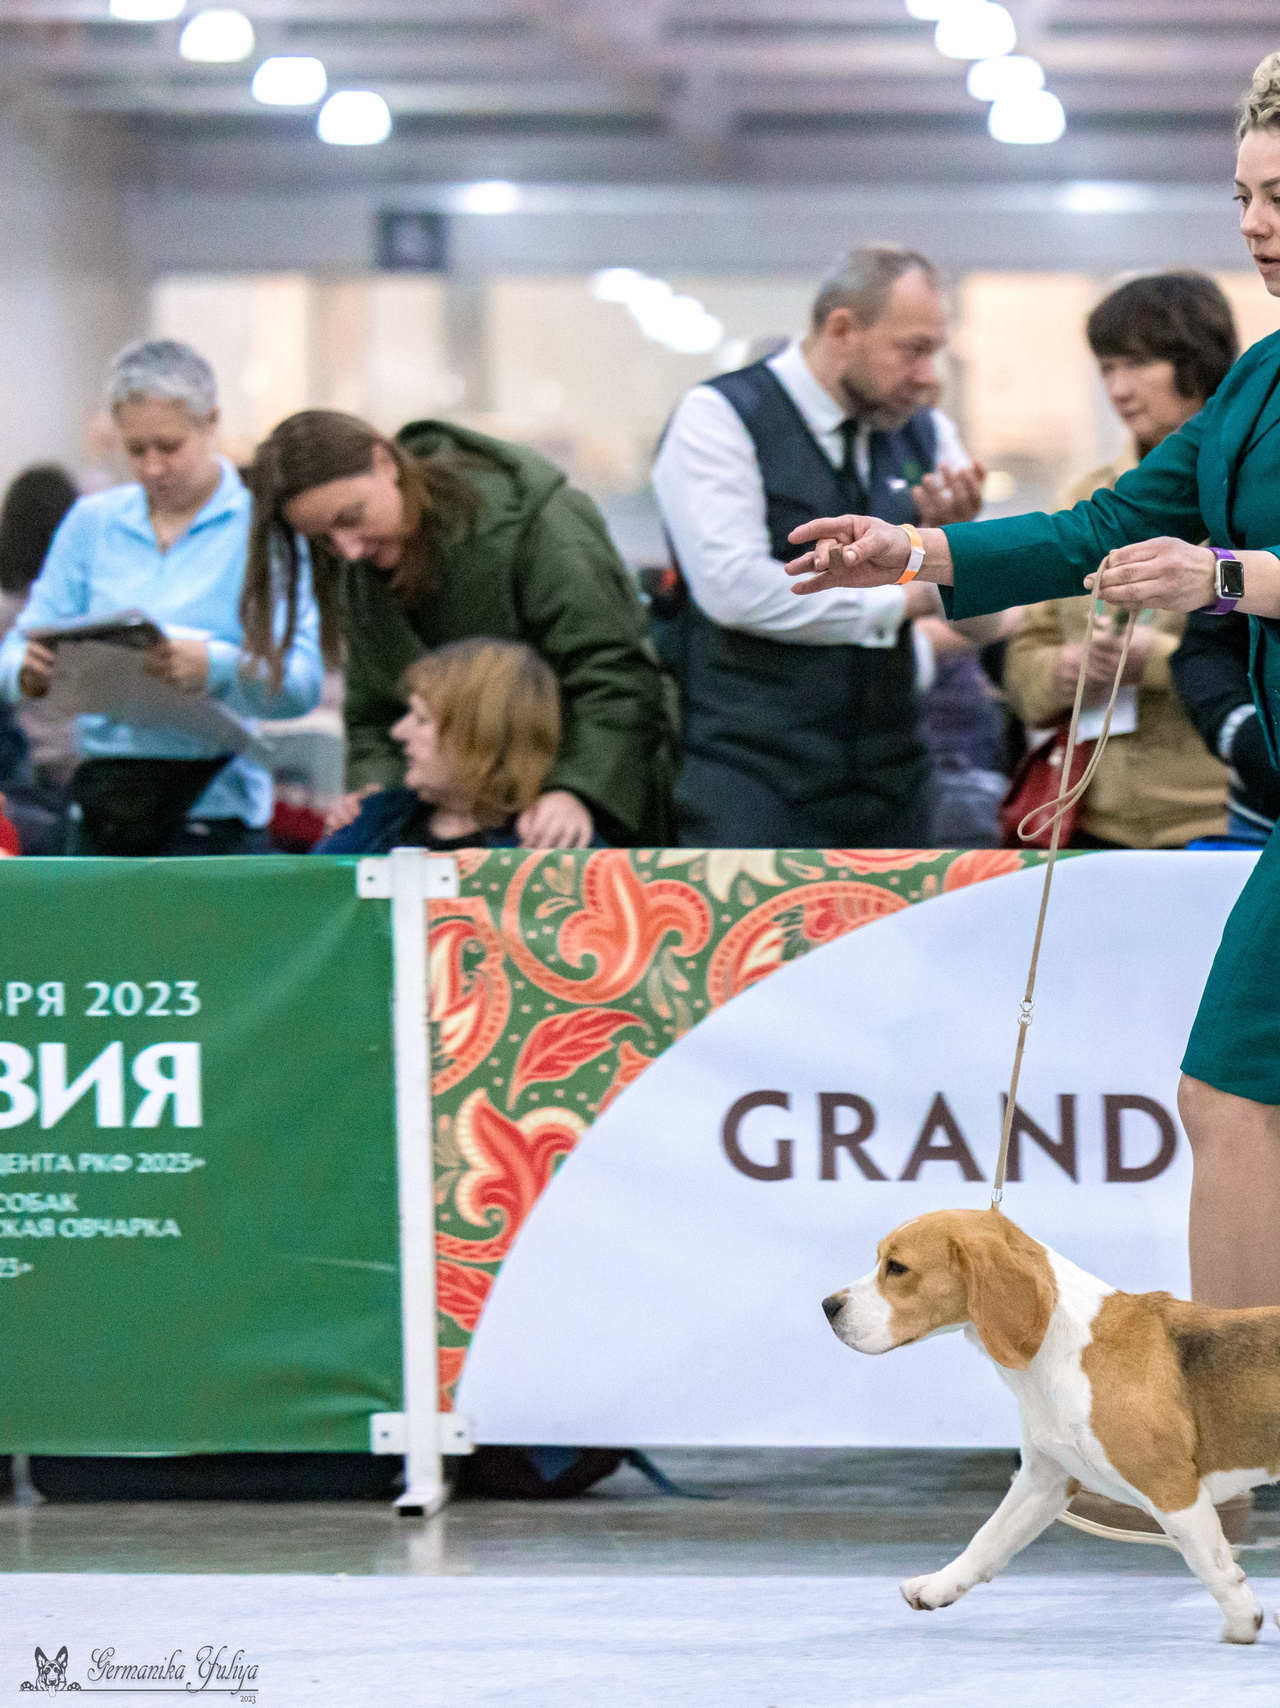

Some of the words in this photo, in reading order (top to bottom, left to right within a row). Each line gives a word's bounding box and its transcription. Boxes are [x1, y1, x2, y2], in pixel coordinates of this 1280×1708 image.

[0, 981, 66, 1017] РЯ
[85, 981, 201, 1017] 2023
[78, 1153, 133, 1173] РКФ
[59, 1218, 182, 1239] ОВЧАРКА
